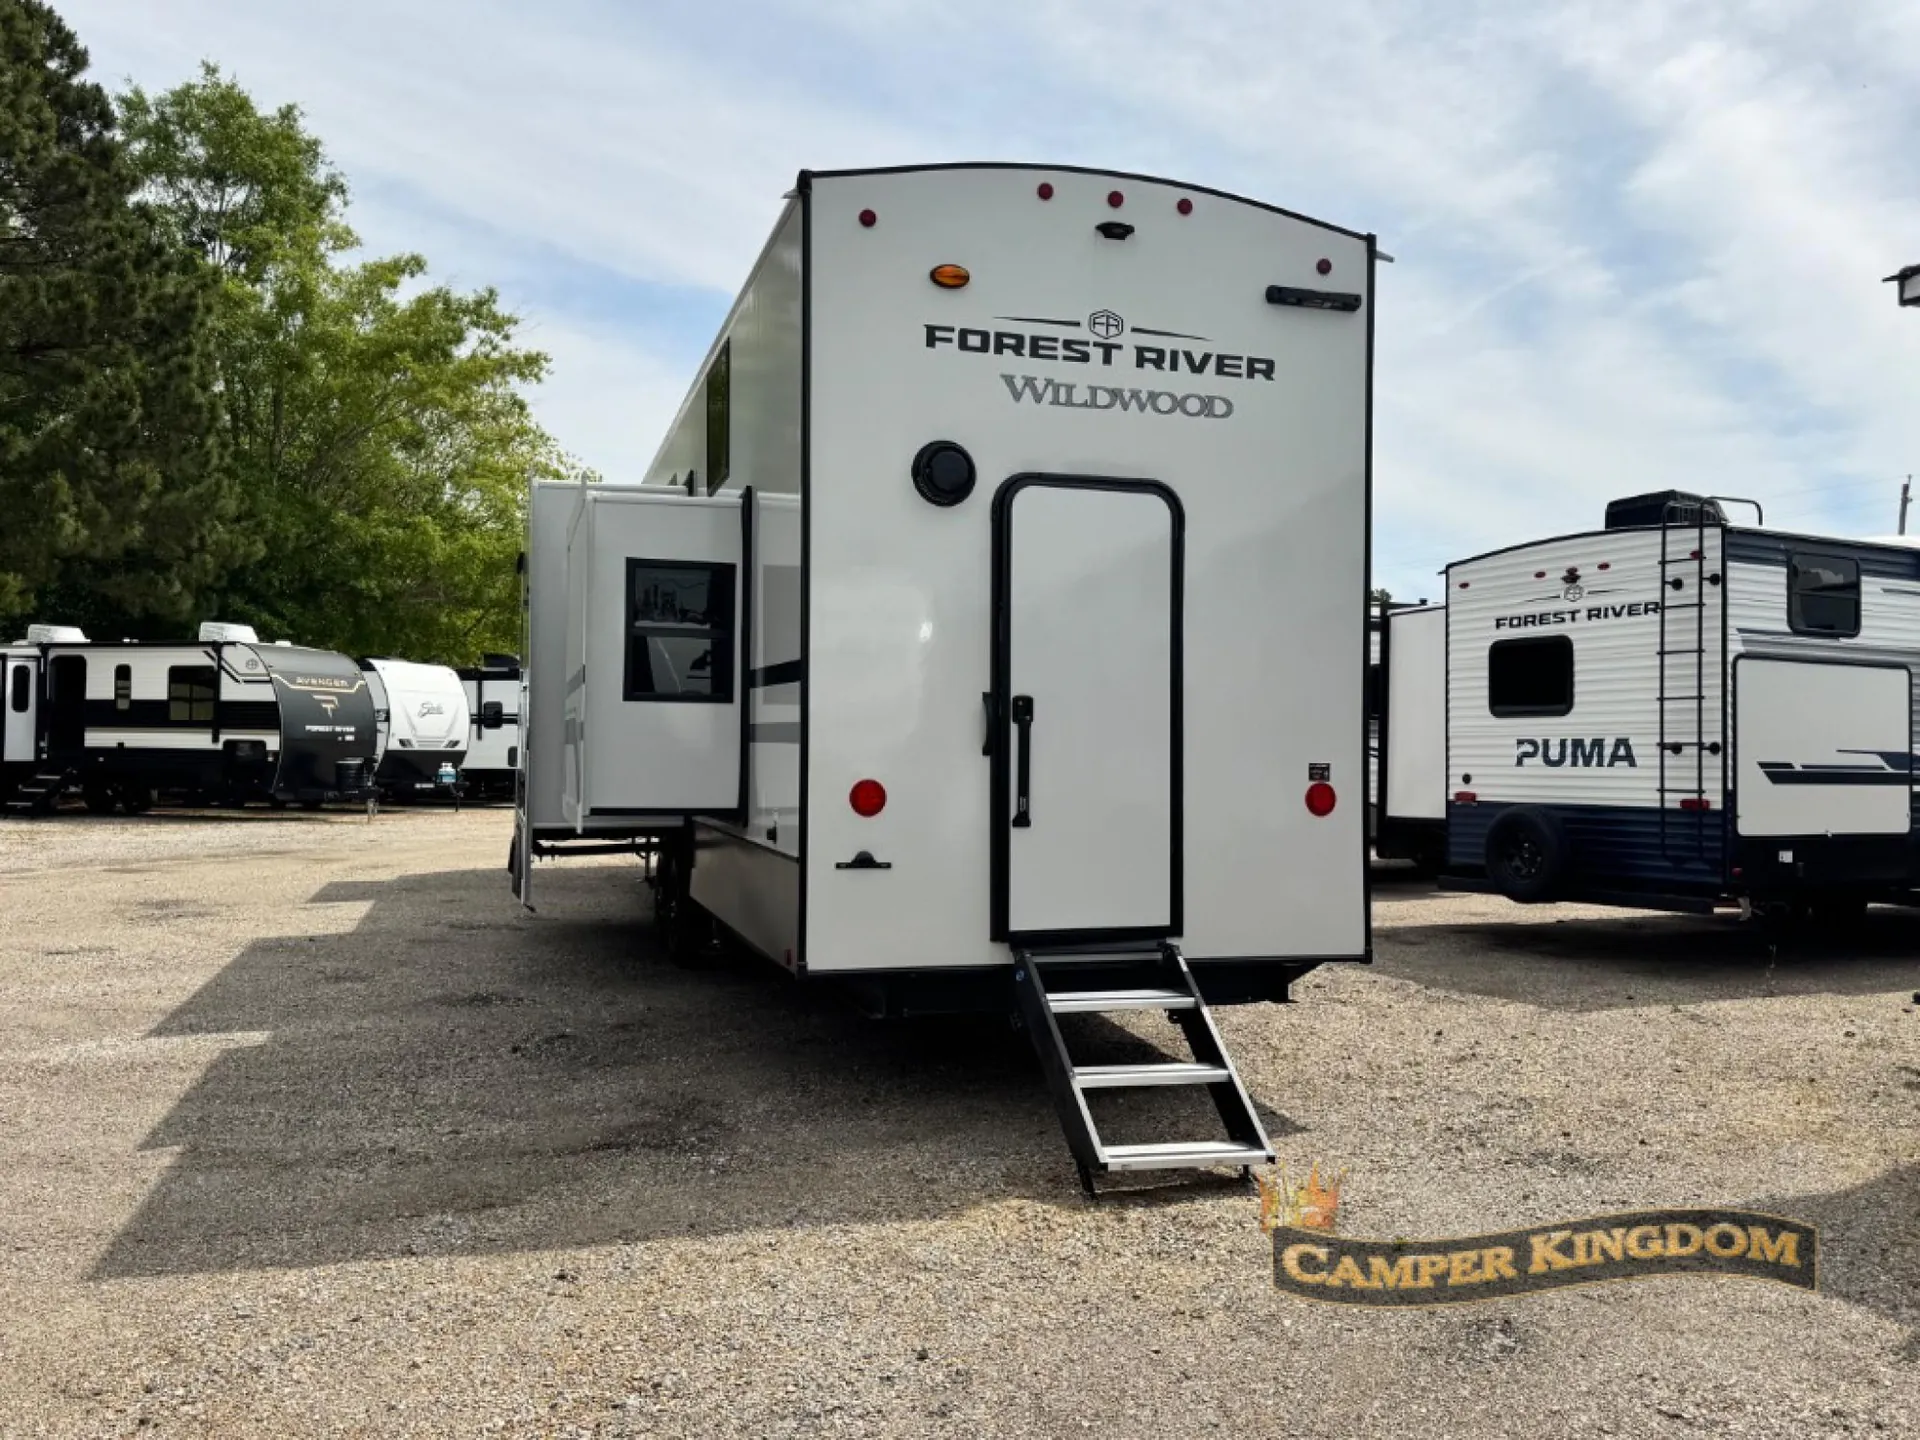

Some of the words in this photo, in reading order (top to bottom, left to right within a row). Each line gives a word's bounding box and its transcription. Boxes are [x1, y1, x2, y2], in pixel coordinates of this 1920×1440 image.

[923, 324, 1124, 366] FOREST
[1133, 345, 1276, 381] RIVER
[1495, 609, 1581, 630] FOREST
[1586, 601, 1661, 622] RIVER
[1515, 738, 1638, 768] PUMA
